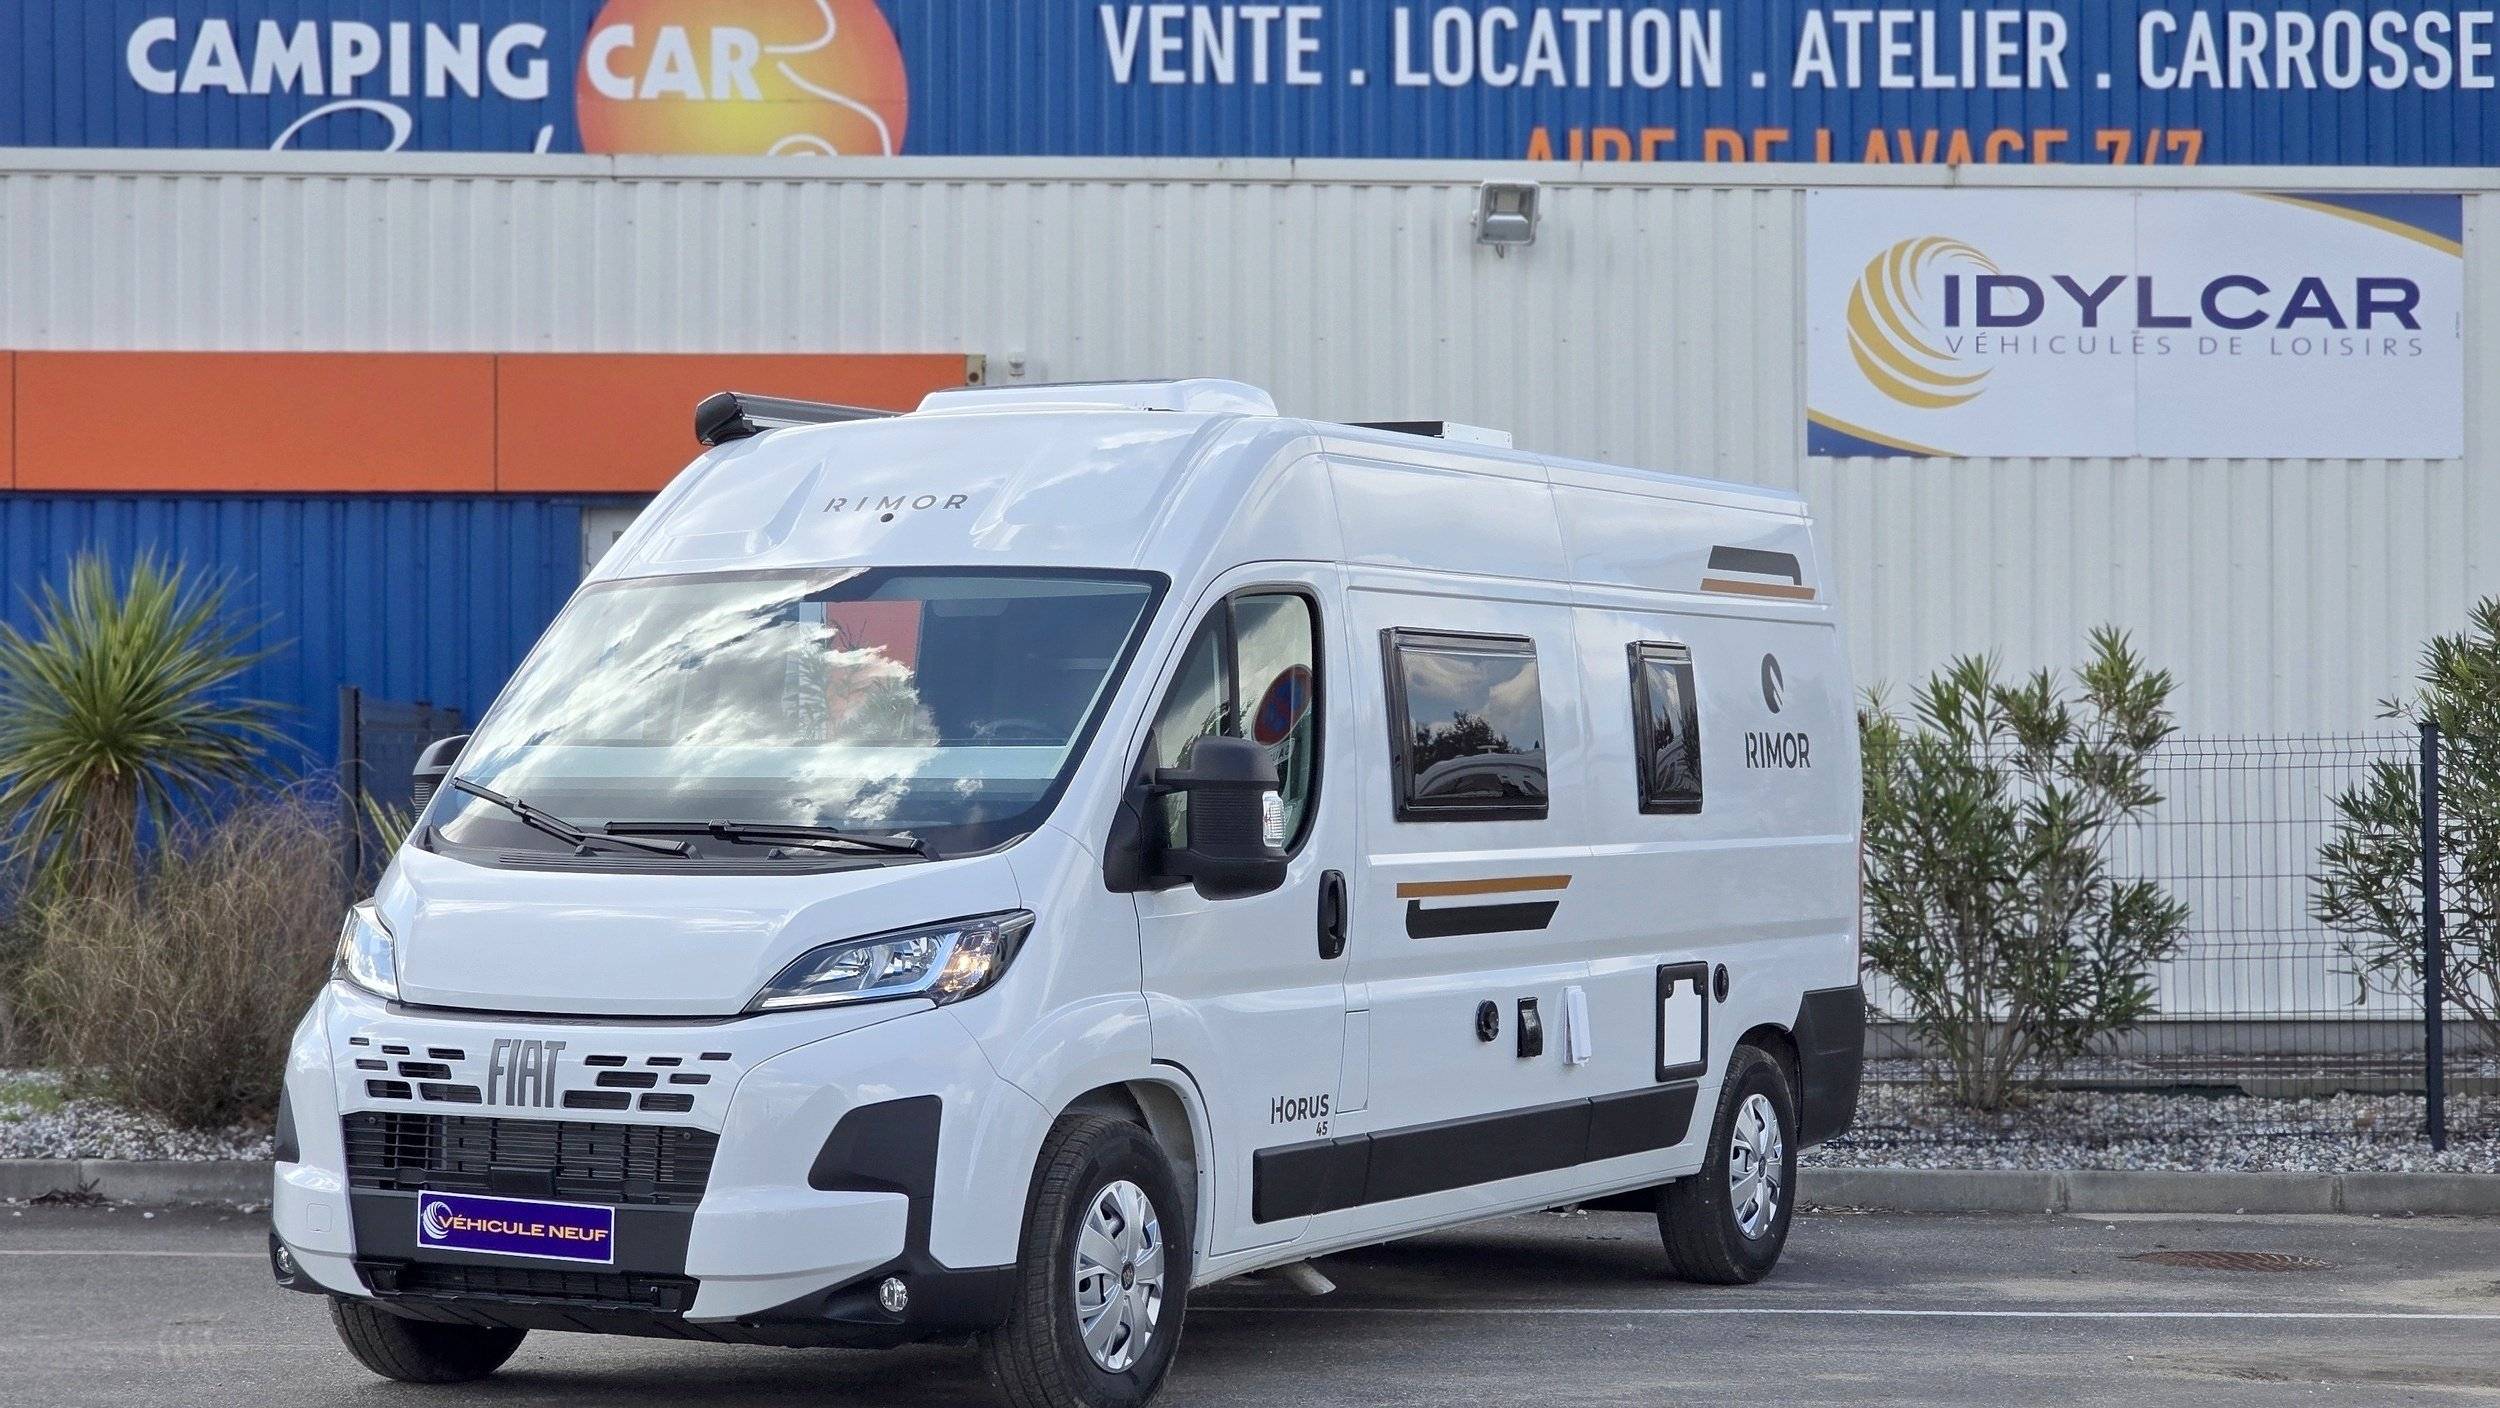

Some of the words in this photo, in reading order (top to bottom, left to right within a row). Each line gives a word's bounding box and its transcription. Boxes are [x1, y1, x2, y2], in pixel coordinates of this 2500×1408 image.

[128, 18, 548, 99] CAMPING
[587, 24, 763, 100] CAR
[1101, 5, 1322, 84] VENTE
[1395, 7, 1722, 88] LOCATION
[1792, 10, 2069, 88] ATELIER
[2139, 11, 2495, 89] CARROSSE
[1945, 275, 2421, 330] IDYLCAR
[1945, 333, 2171, 355] VÉHICULES
[2199, 336, 2241, 355] DE
[2271, 337, 2423, 357] LOISIRS
[823, 494, 968, 512] RIMOR
[1745, 732, 1811, 768] RIMOR
[487, 1038, 566, 1108] FIAT
[1270, 1093, 1329, 1125] HORUS
[1315, 1121, 1328, 1136] 45
[438, 1214, 545, 1237] VÉHICULE
[548, 1226, 609, 1242] NEUF
